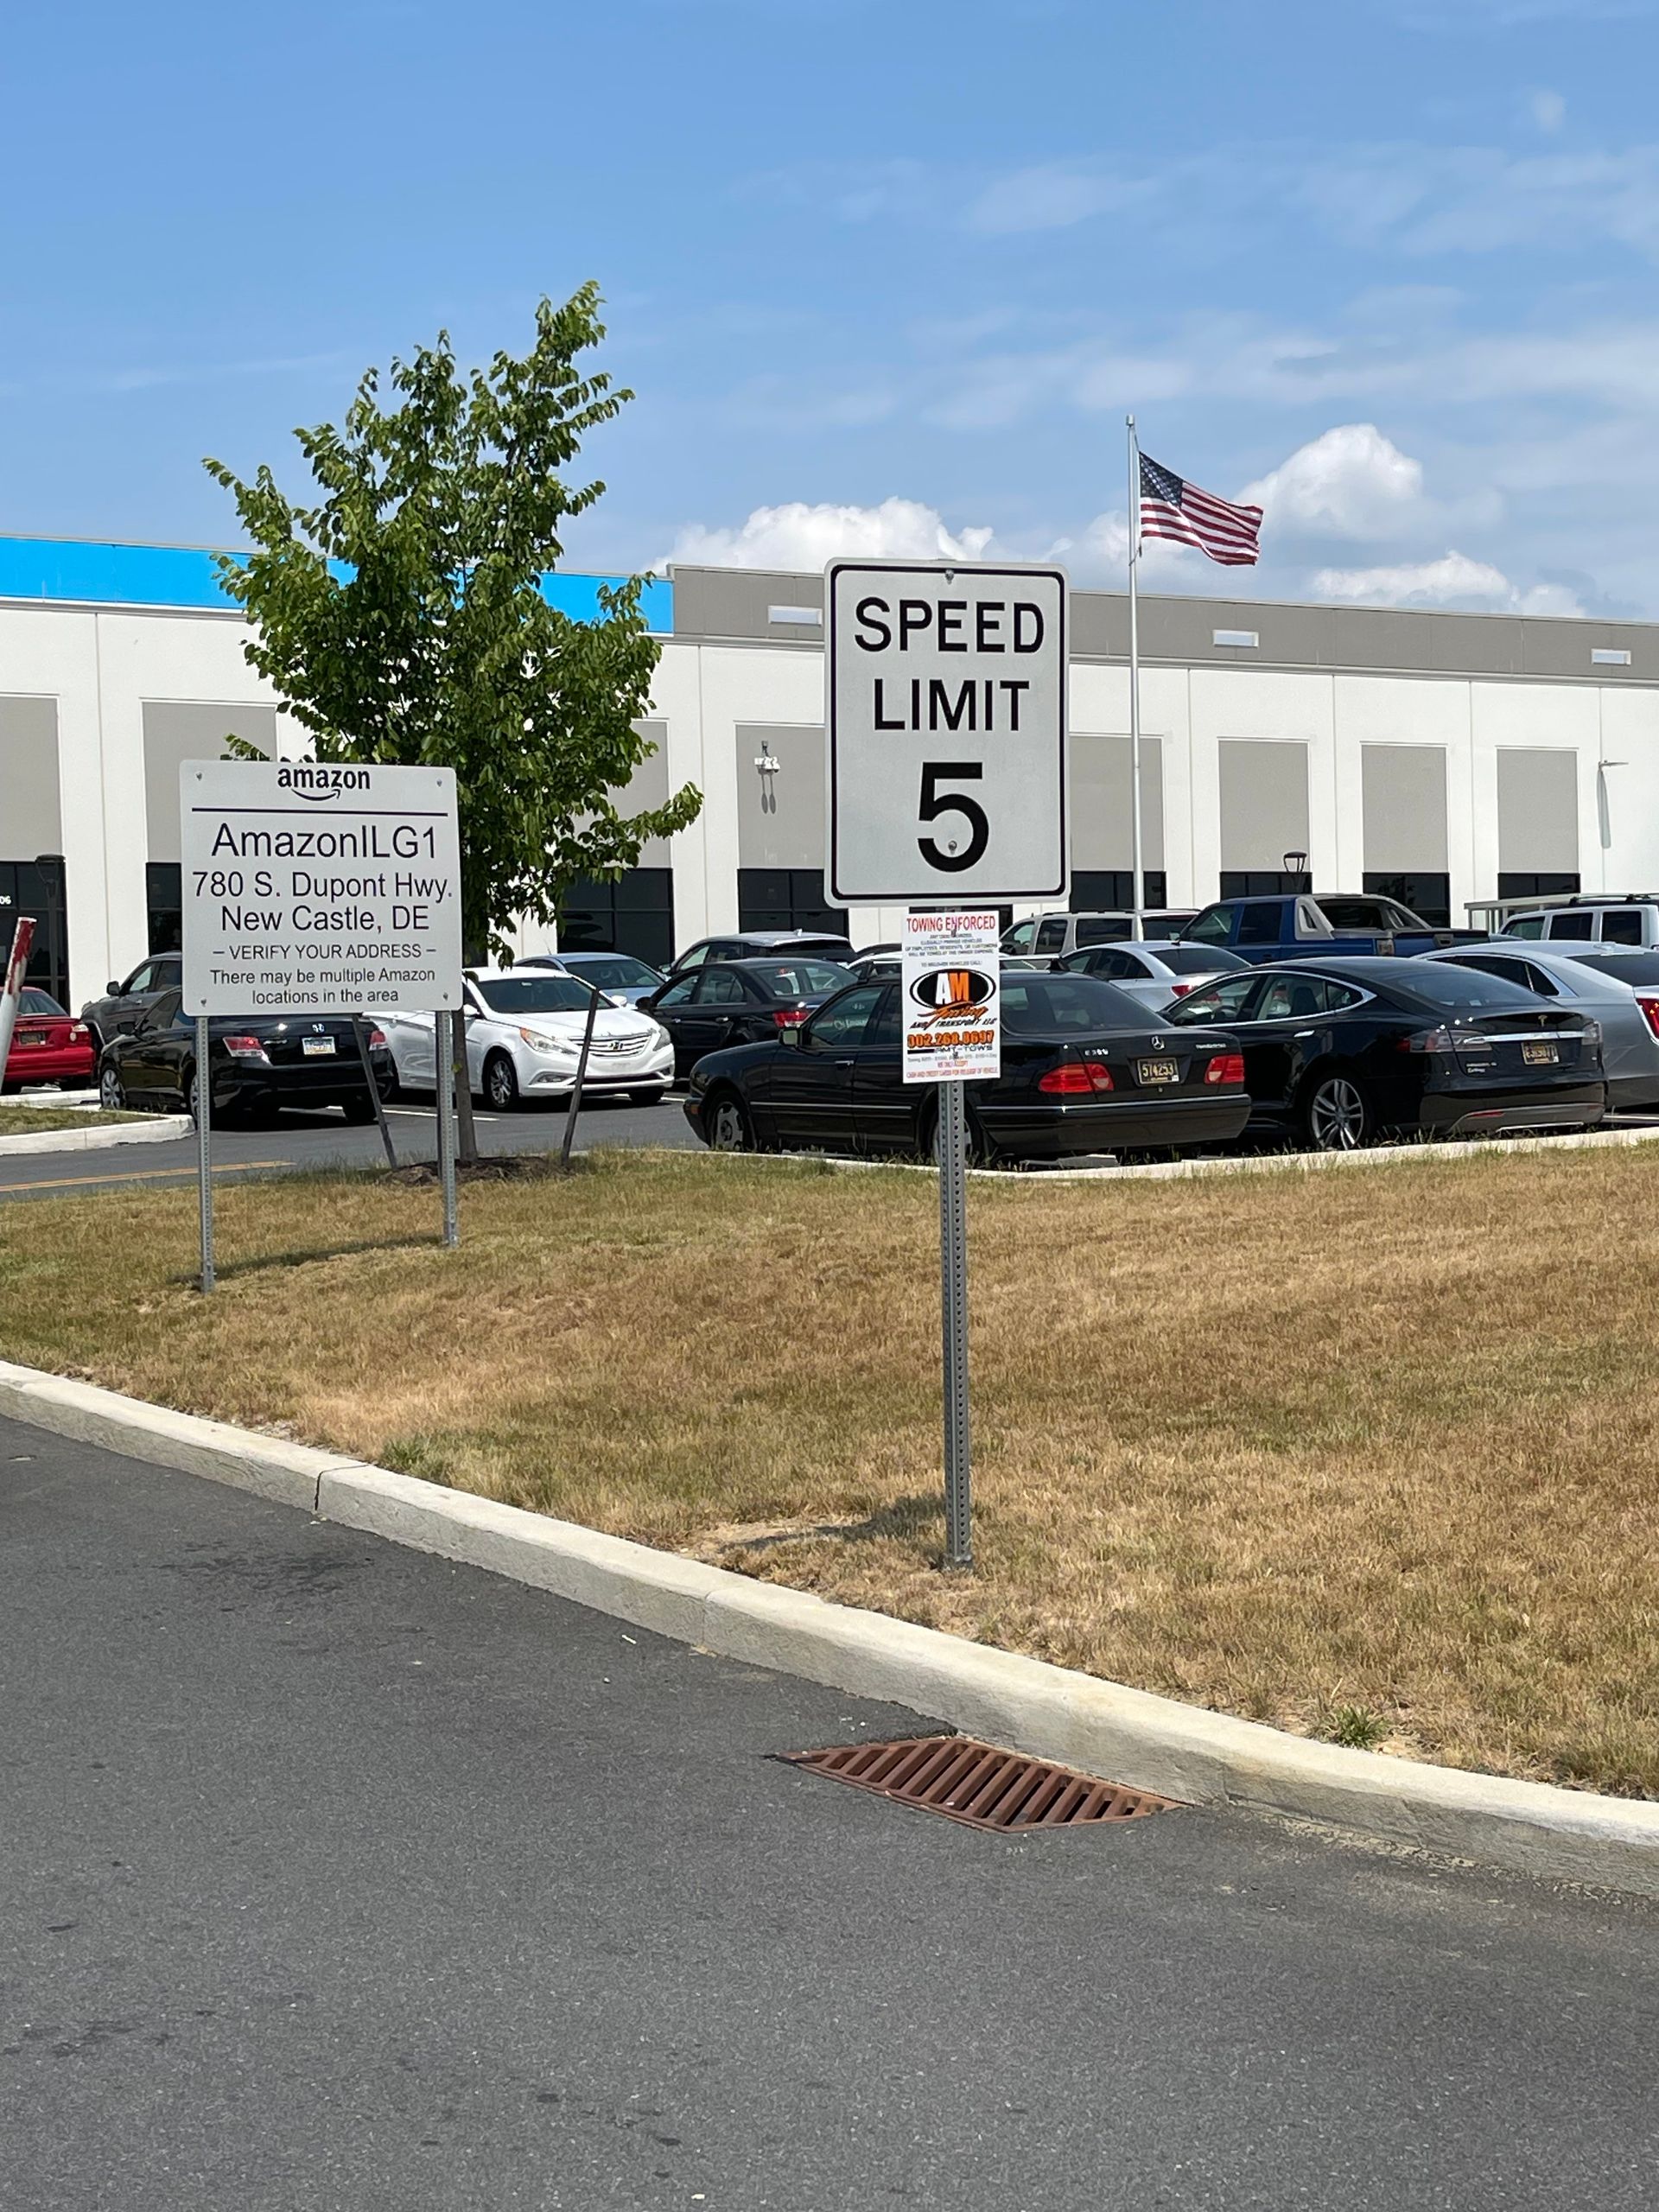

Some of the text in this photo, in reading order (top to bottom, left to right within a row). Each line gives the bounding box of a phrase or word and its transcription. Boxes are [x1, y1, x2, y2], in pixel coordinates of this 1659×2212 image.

[855, 596, 1045, 653] SPEED
[874, 678, 1030, 731] LIMIT
[277, 768, 371, 790] amazon
[917, 761, 989, 873] 5
[211, 823, 435, 859] AmazonILG1
[193, 871, 453, 904] 780 S. Dupont Hwy.
[221, 904, 429, 934] New Castle, DE
[906, 916, 996, 933] TOWING ENFORCED
[229, 943, 422, 960] VERIFY YOUR ADDRESS
[210, 967, 435, 987] There may be multiple Amazon
[935, 972, 970, 1005] AM
[251, 988, 399, 1004] locations in the area
